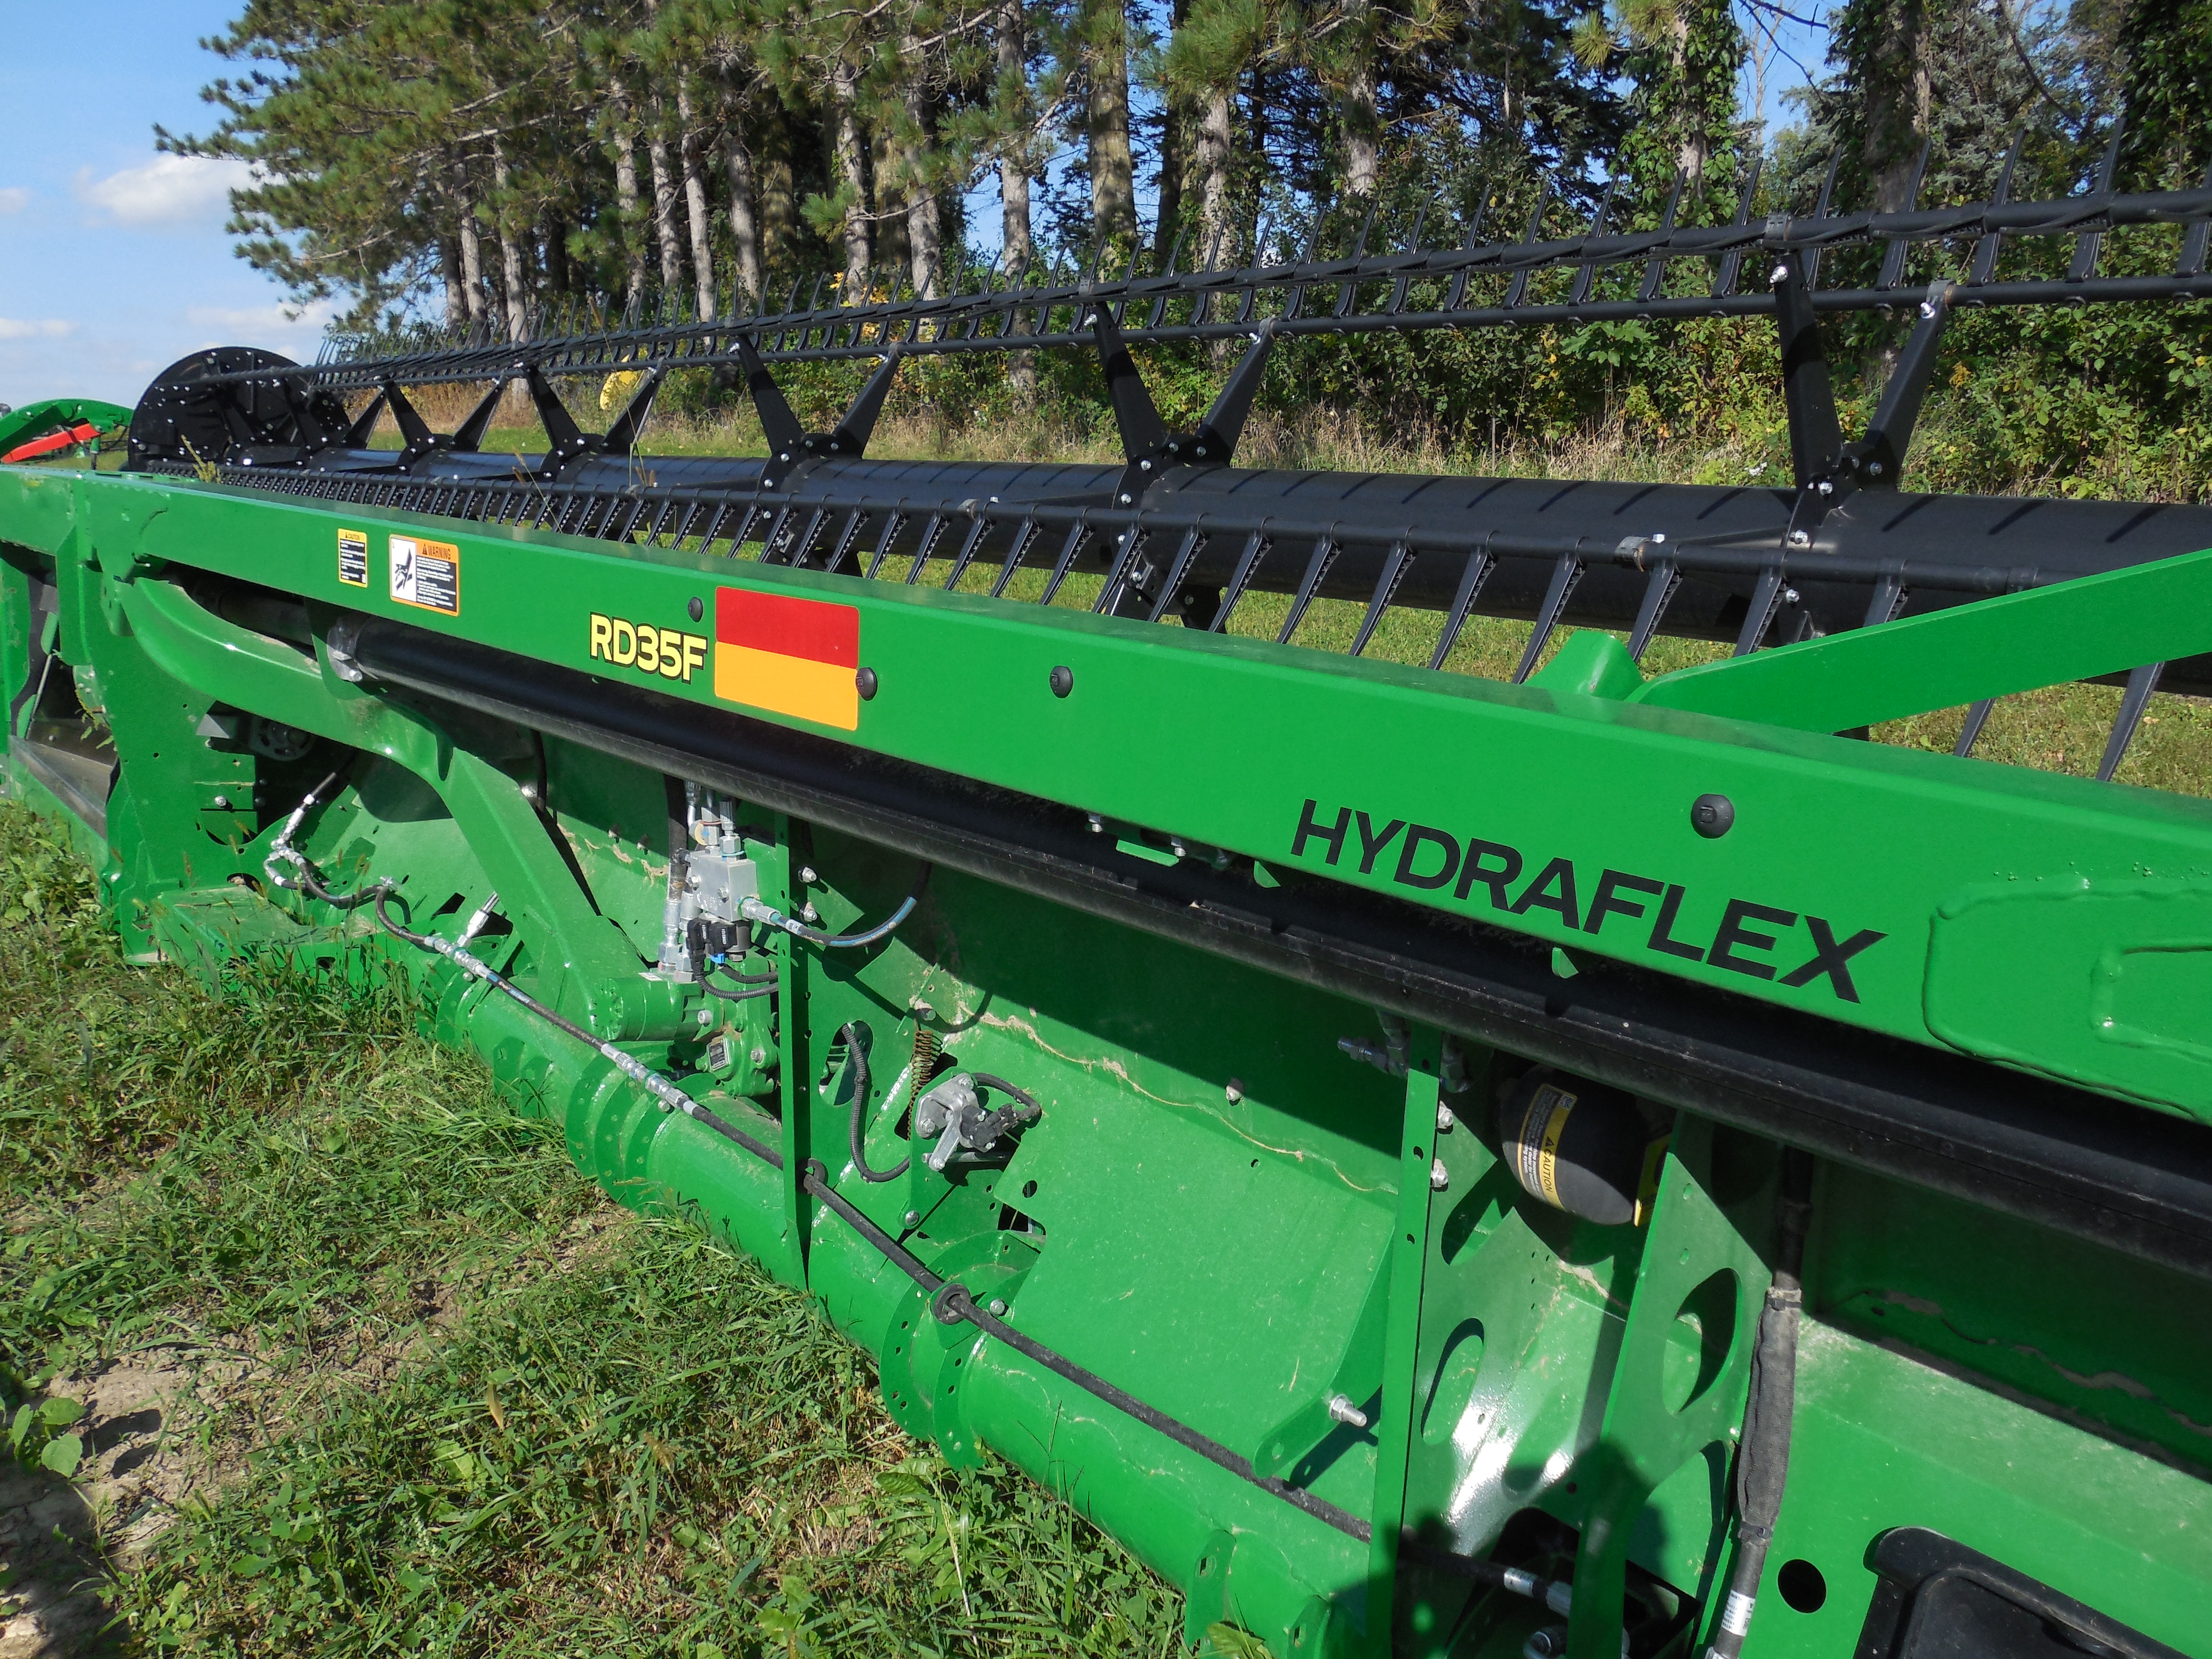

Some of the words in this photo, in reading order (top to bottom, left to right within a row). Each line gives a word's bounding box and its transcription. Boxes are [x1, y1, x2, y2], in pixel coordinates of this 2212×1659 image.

[428, 545, 451, 560] WARNING
[590, 612, 708, 684] RD35F
[1290, 798, 1889, 1005] HYDRAFLEX
[1543, 1149, 1553, 1193] CAUTION
